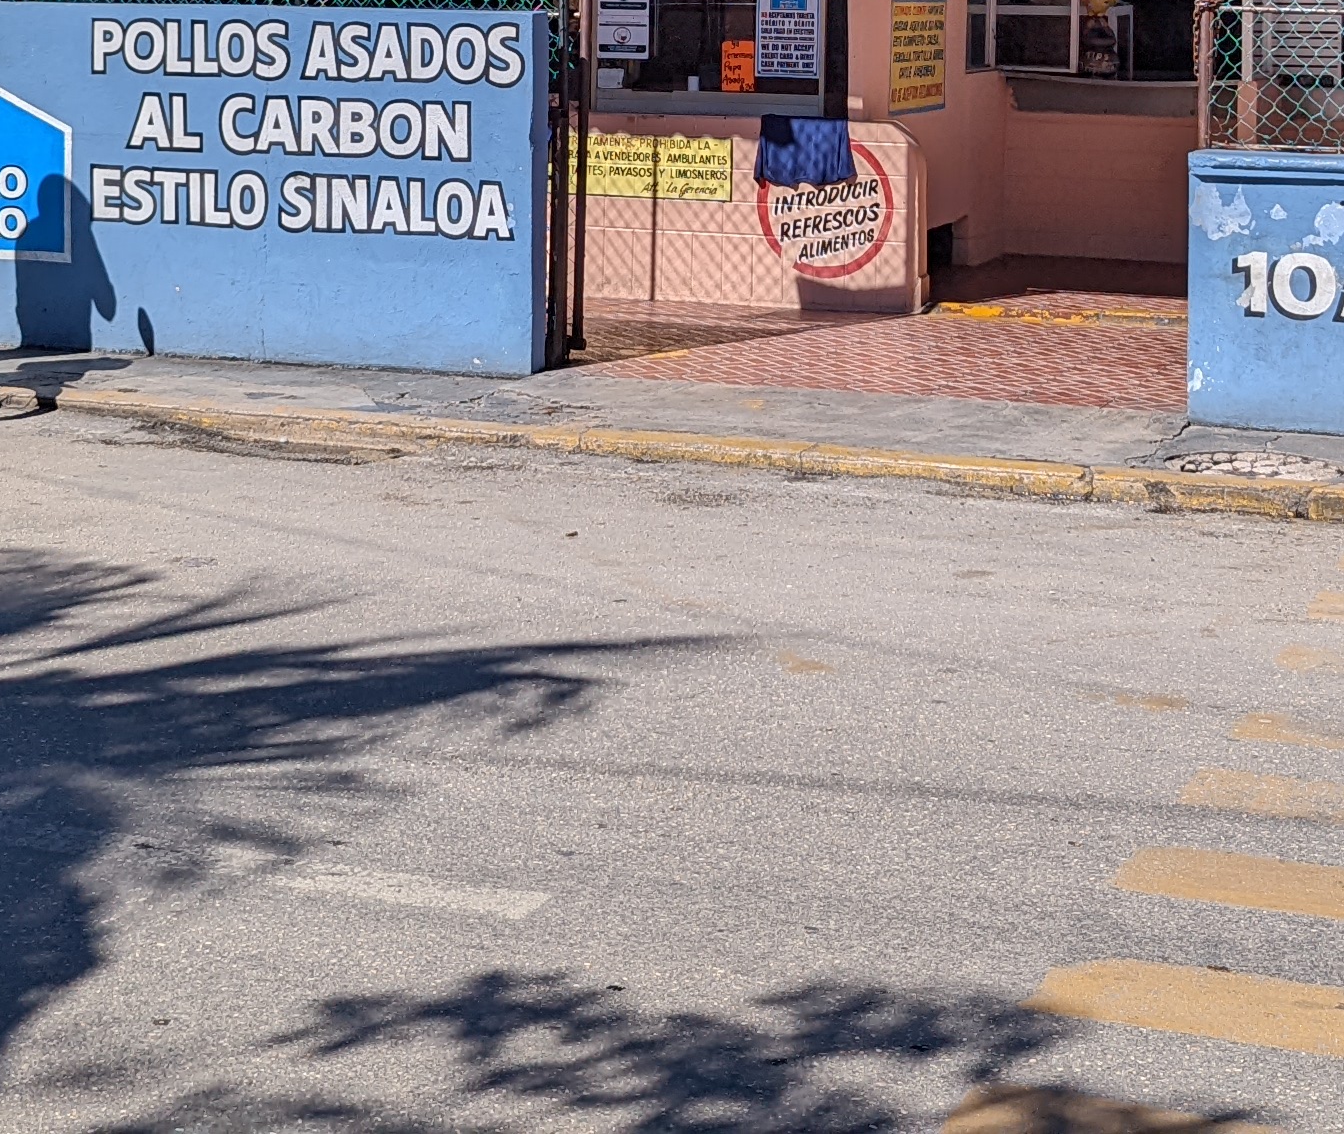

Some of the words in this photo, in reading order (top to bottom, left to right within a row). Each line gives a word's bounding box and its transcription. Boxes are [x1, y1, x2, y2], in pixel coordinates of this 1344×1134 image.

[91, 18, 290, 81] POLLOS
[300, 21, 525, 89] ASADOS
[125, 92, 205, 153] AL
[219, 93, 472, 162] CARBON
[639, 138, 692, 150] PROHIBIDA
[697, 139, 711, 150] LA
[594, 150, 601, 159] A
[602, 150, 662, 163] VENDEDORES
[666, 153, 728, 165] AMBULANTES
[609, 167, 652, 178] PAYASOS
[658, 168, 666, 179] Y
[669, 169, 728, 181] LIMOSNEROS
[90, 164, 269, 231] ESTILO
[277, 172, 516, 242] SINALOA
[774, 178, 879, 216] INTRODUCIR
[779, 202, 881, 243] REFRESCOS
[797, 228, 875, 262] ALIMENTOS
